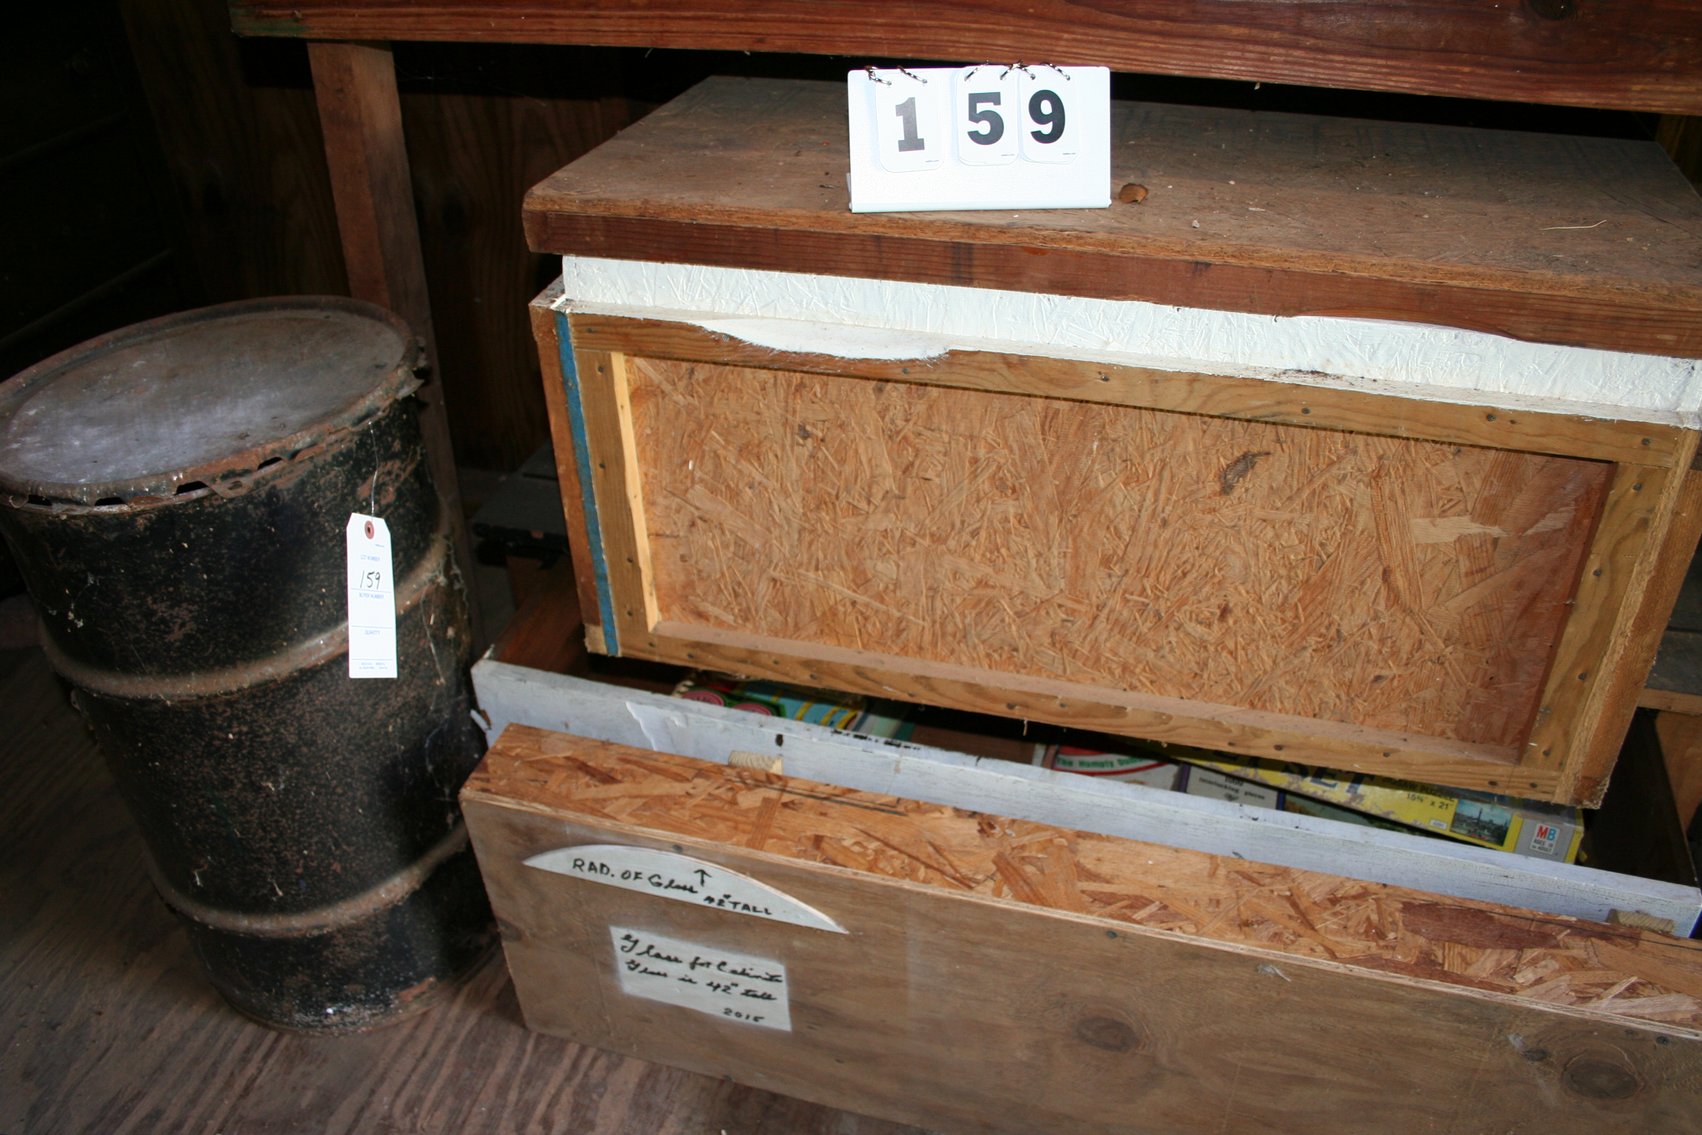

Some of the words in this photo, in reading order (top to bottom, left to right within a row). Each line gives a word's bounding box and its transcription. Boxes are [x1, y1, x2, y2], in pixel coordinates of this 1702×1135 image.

[895, 88, 1067, 153] 159
[360, 569, 381, 590] 159
[1536, 825, 1557, 842] MB
[572, 858, 616, 878] RAD.
[620, 870, 643, 881] OF
